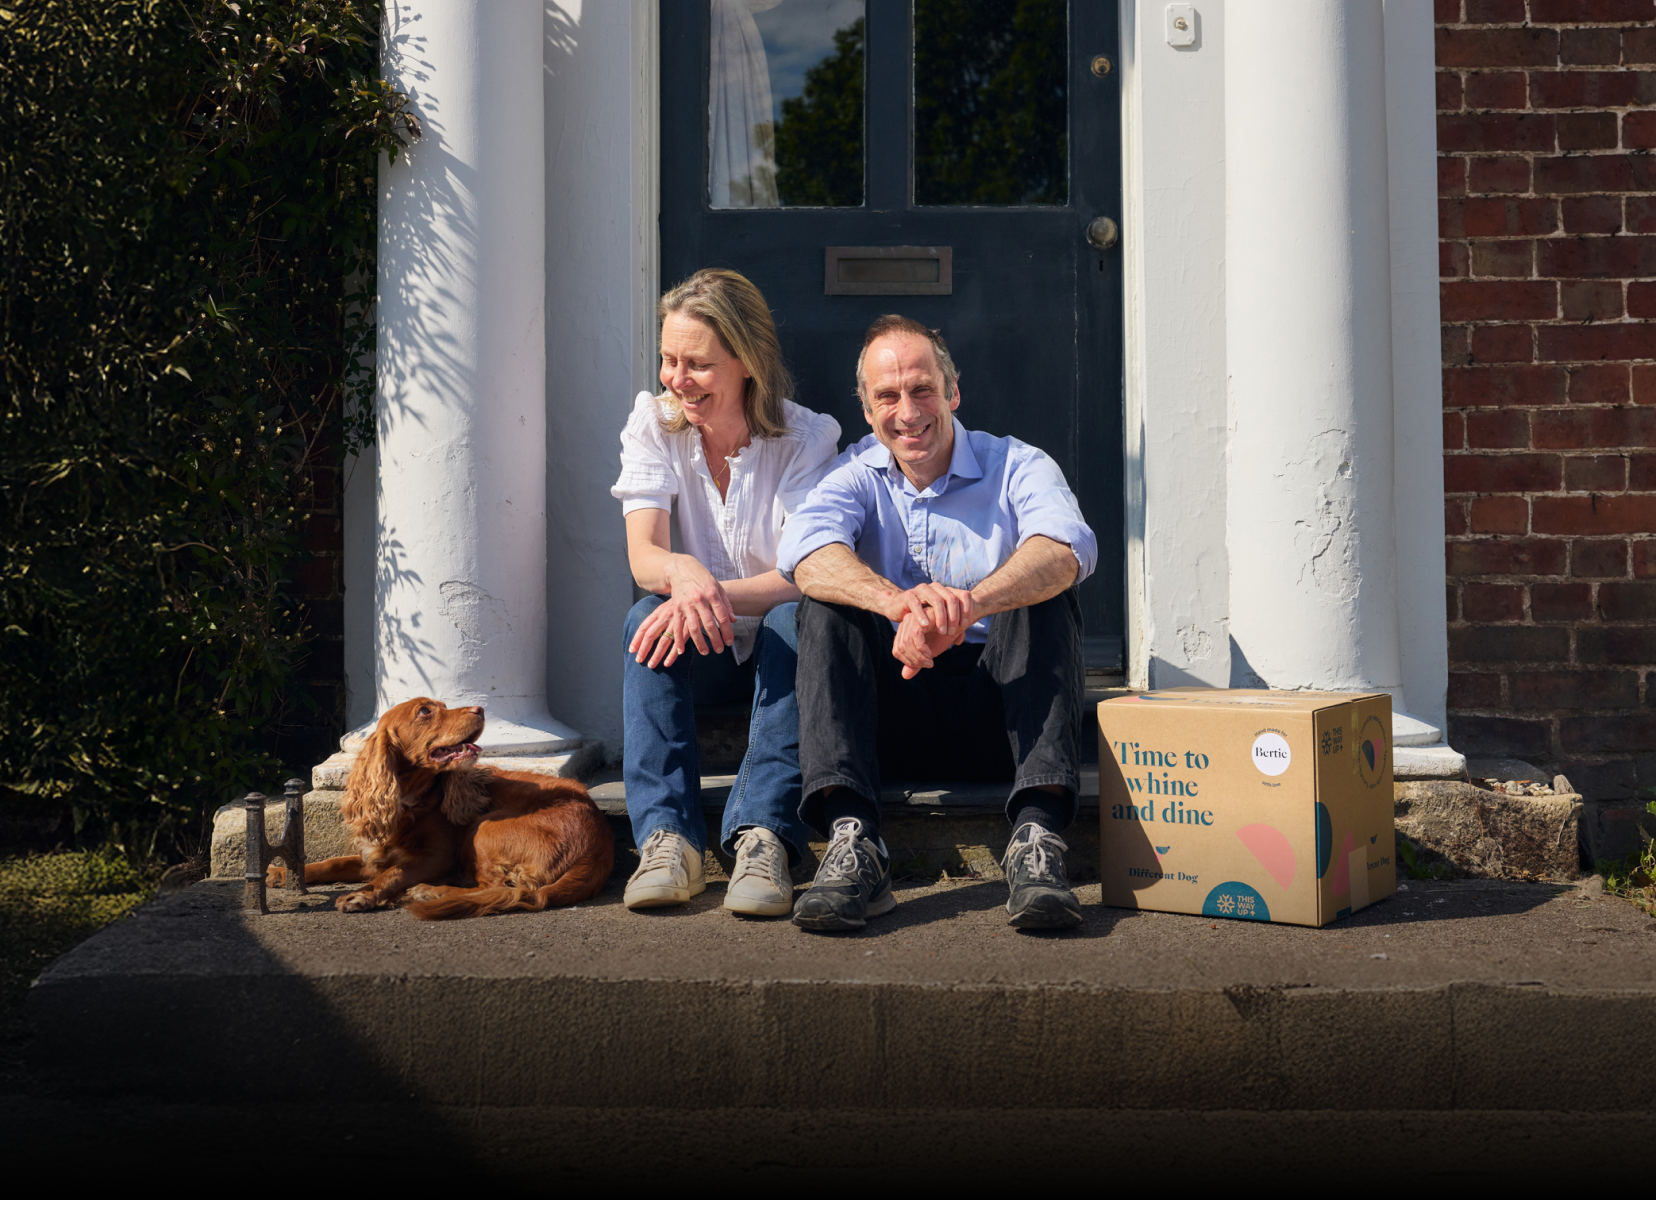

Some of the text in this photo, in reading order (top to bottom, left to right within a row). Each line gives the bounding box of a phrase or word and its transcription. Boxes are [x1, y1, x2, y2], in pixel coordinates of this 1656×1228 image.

[1332, 726, 1343, 736] THIS
[1333, 735, 1343, 745] WAY
[1255, 747, 1288, 759] Bertie
[1333, 745, 1340, 754] UP
[1114, 741, 1209, 770] Time to
[1125, 772, 1199, 797] whine
[1111, 800, 1214, 826] and dine
[1128, 867, 1199, 884] Different Dog
[1237, 895, 1255, 903] THIS
[1237, 902, 1256, 910] WAY
